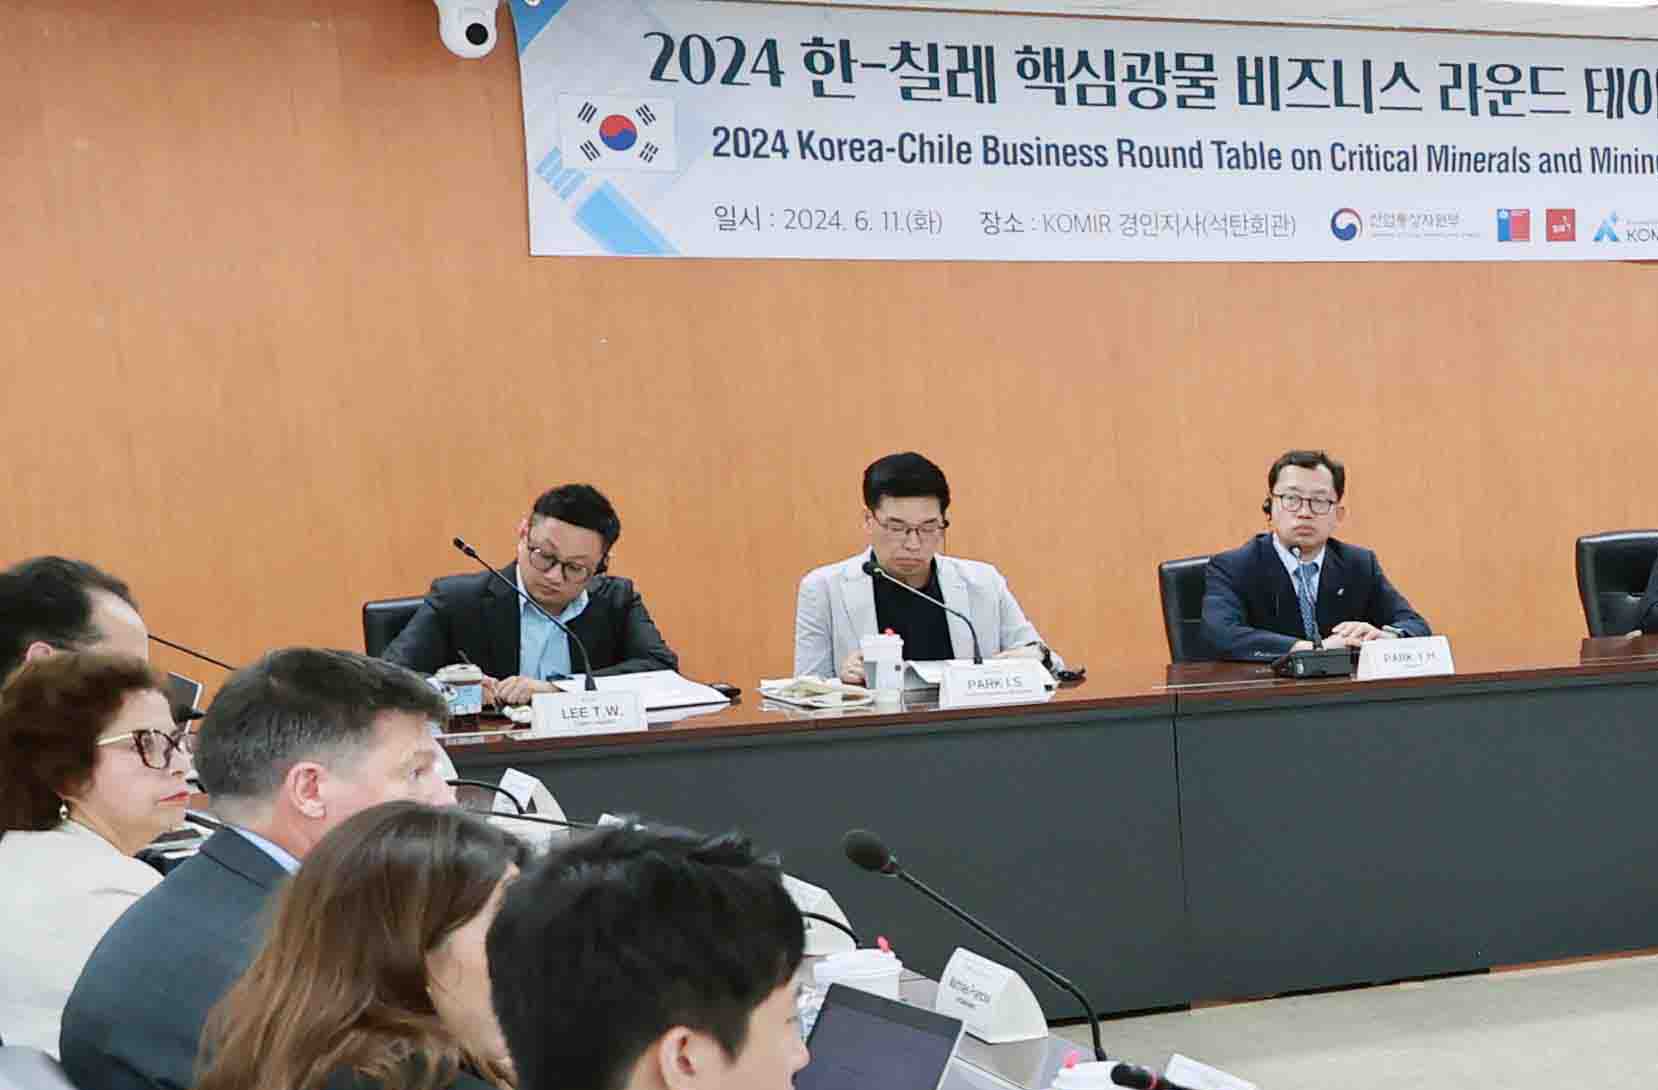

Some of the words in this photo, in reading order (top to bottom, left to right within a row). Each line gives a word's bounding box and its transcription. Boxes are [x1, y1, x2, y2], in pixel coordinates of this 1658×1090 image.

[643, 32, 784, 88] 2024
[801, 36, 998, 104] 한-칠레
[1015, 45, 1218, 111] 핵심광물
[1237, 55, 1423, 115] 비즈니스
[1439, 62, 1571, 119] 라운드
[712, 126, 789, 160] 2024
[797, 129, 973, 166] Korea-Chile
[981, 135, 1108, 168] Business
[1117, 138, 1204, 171] Round
[1212, 140, 1282, 172] Table
[1292, 150, 1321, 172] on
[1330, 142, 1418, 173] Critical
[1427, 144, 1531, 174] Minerals
[1539, 146, 1582, 174] and
[714, 205, 761, 232] 일시
[784, 208, 848, 231] 2024.
[855, 210, 873, 231] 6.
[979, 210, 1025, 236] 장소
[1043, 213, 1112, 234] KOMIR
[1119, 211, 1297, 239] 경인지사(석탄회관)
[561, 706, 588, 721] LEE
